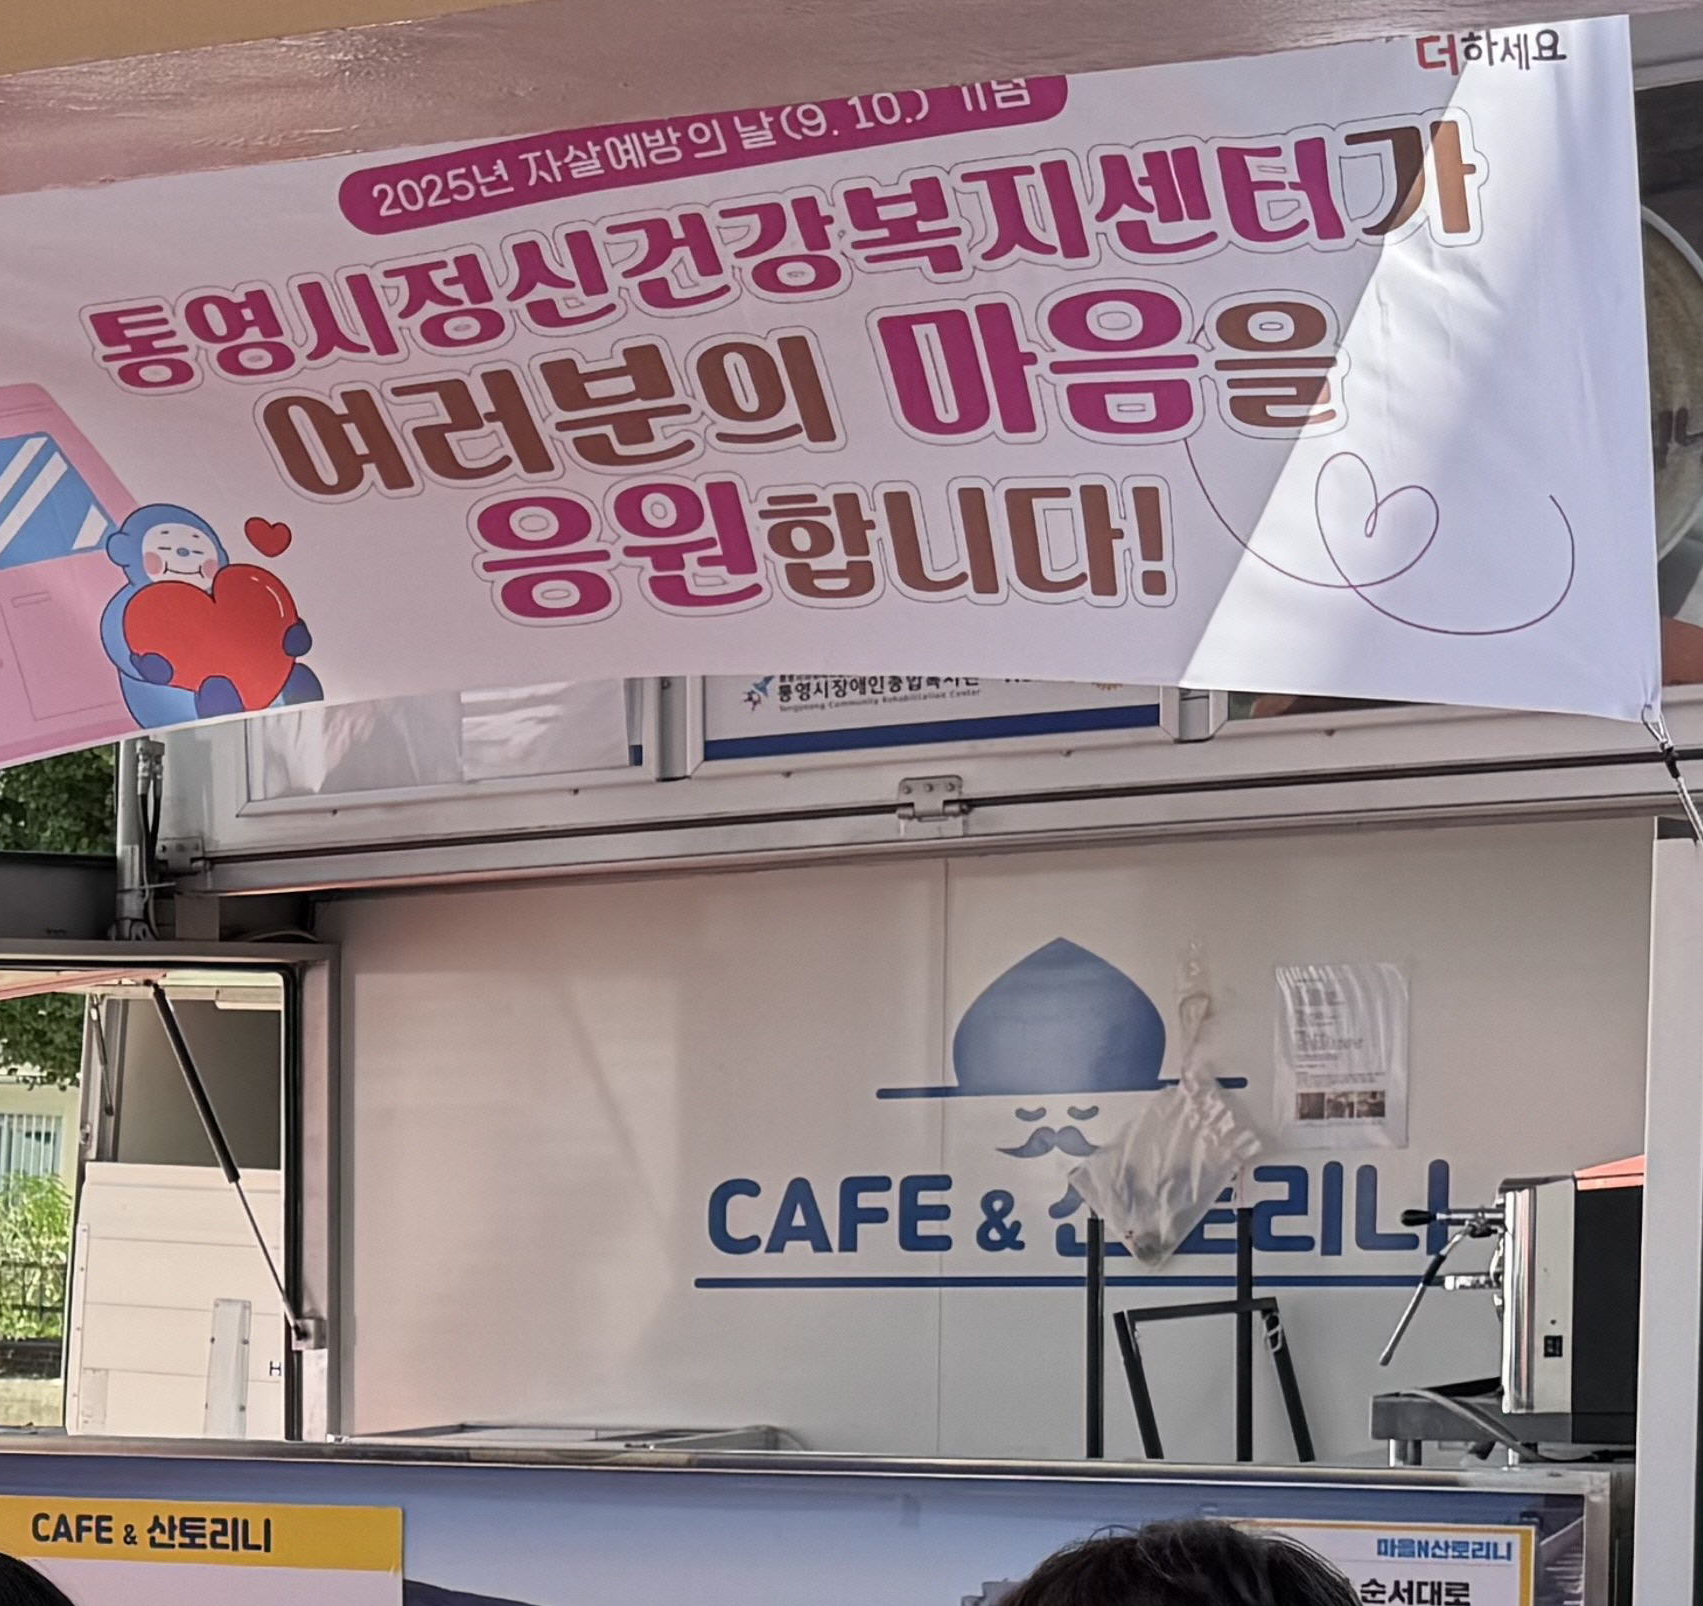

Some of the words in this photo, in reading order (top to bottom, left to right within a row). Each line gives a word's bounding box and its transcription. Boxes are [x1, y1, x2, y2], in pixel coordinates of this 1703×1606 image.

[1415, 29, 1567, 75] 더하세요
[372, 158, 514, 217] 2025년
[519, 119, 727, 187] 자살예방의
[90, 121, 1480, 391] 통영시정신건강복지센터가
[261, 335, 837, 494] 여러분의
[879, 287, 1341, 436] 마음을
[476, 480, 1168, 619] 응원합니다!
[709, 1174, 952, 1256] CAFE
[976, 1189, 1026, 1252] &
[31, 1513, 114, 1545] CAFE
[123, 1523, 139, 1546] &
[146, 1515, 273, 1553] 산토리니
